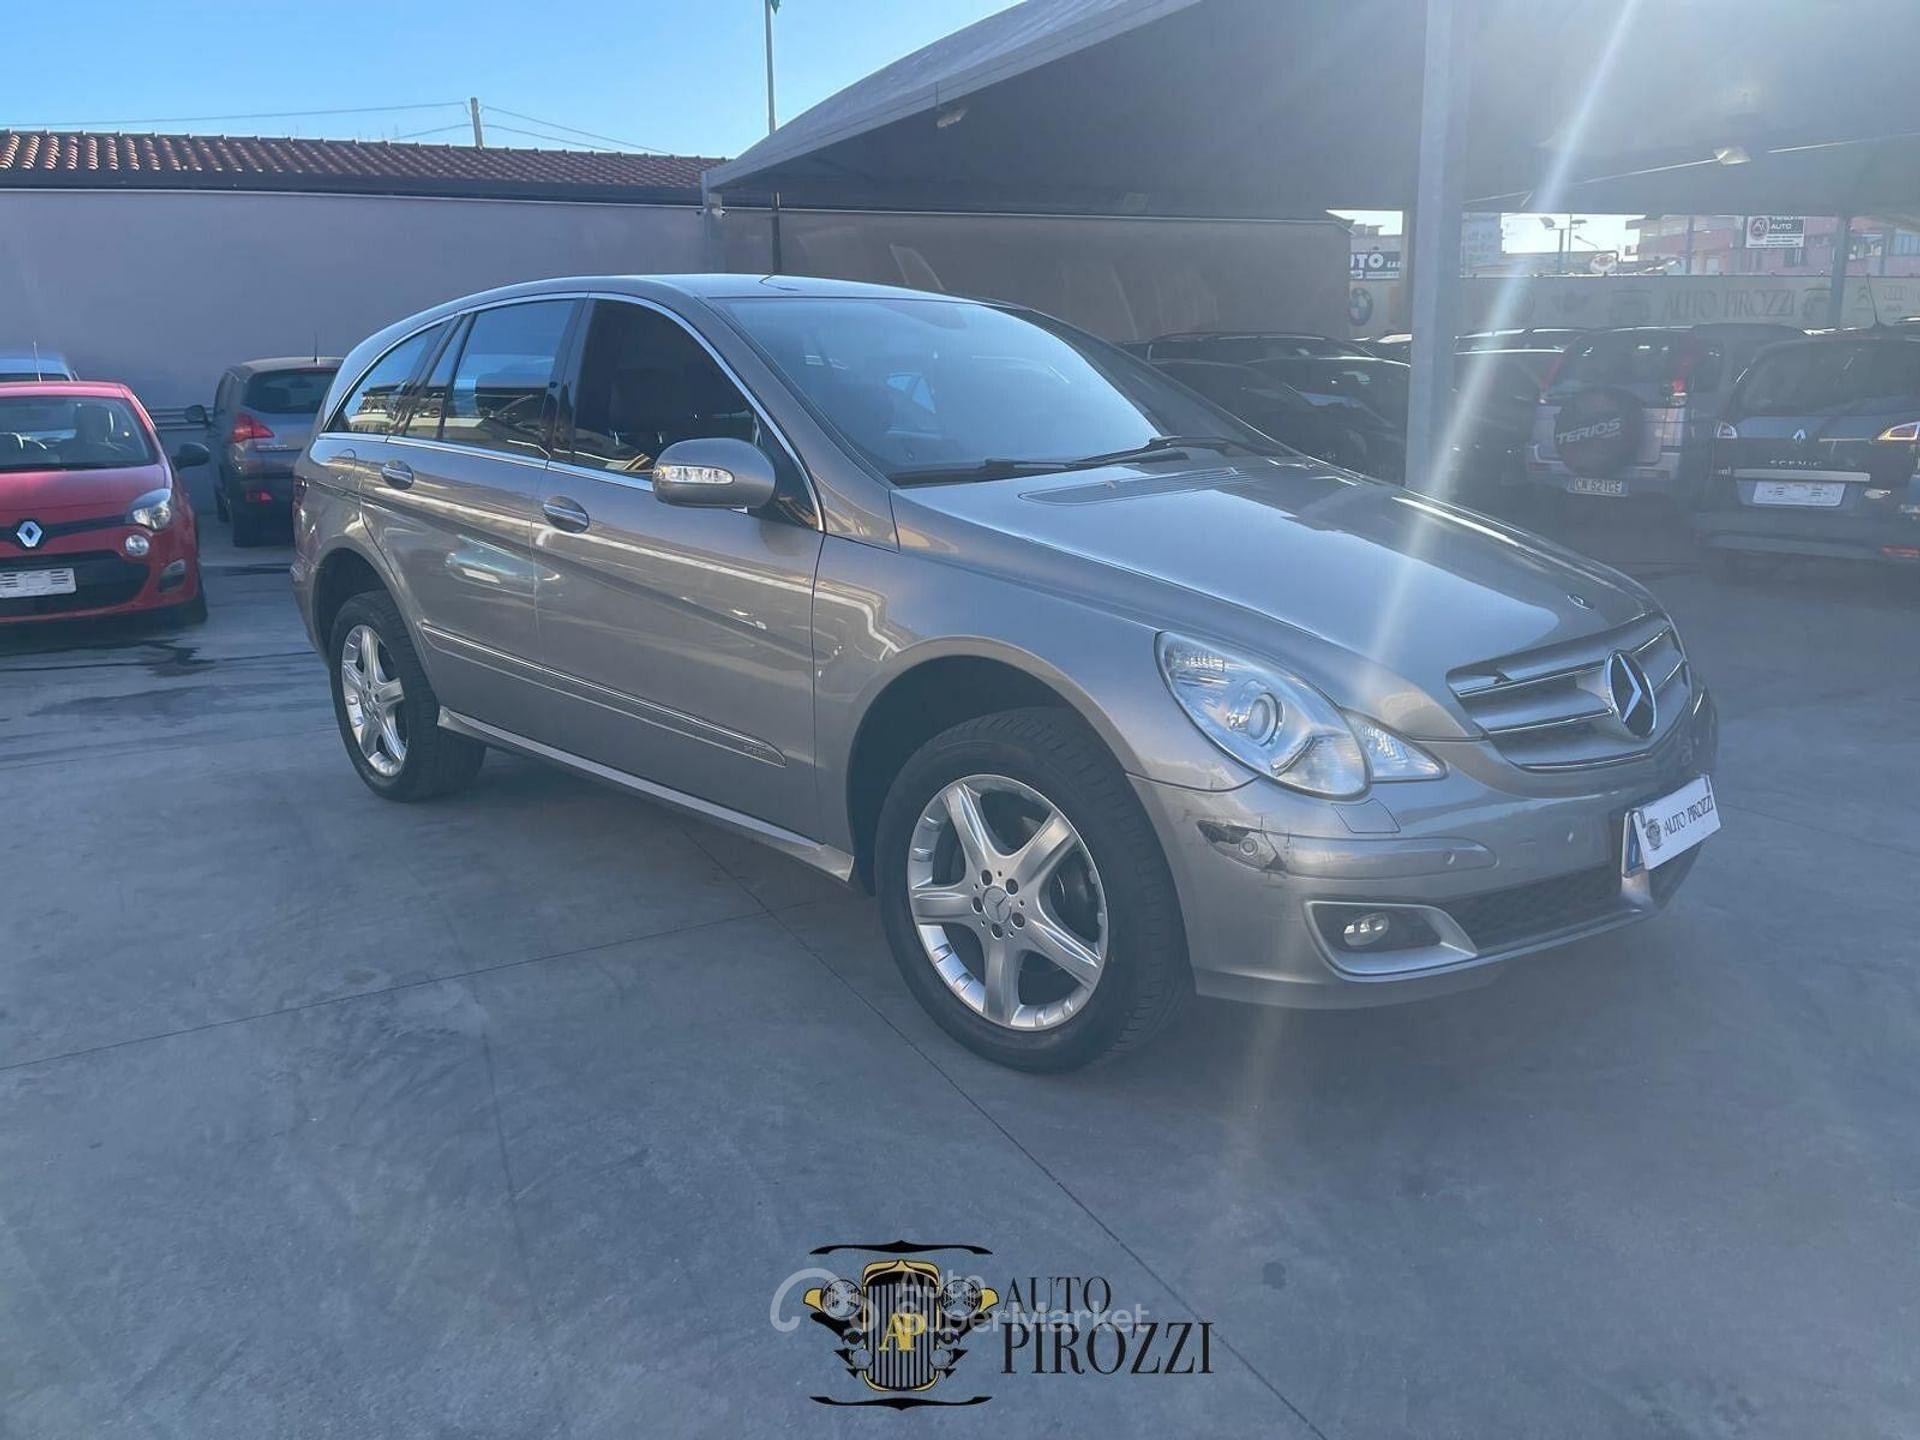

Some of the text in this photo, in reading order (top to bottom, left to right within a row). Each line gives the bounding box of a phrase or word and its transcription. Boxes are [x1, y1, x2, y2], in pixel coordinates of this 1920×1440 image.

[1555, 417, 1621, 445] TERIOS
[1663, 794, 1714, 837] AUTO PIROZZI
